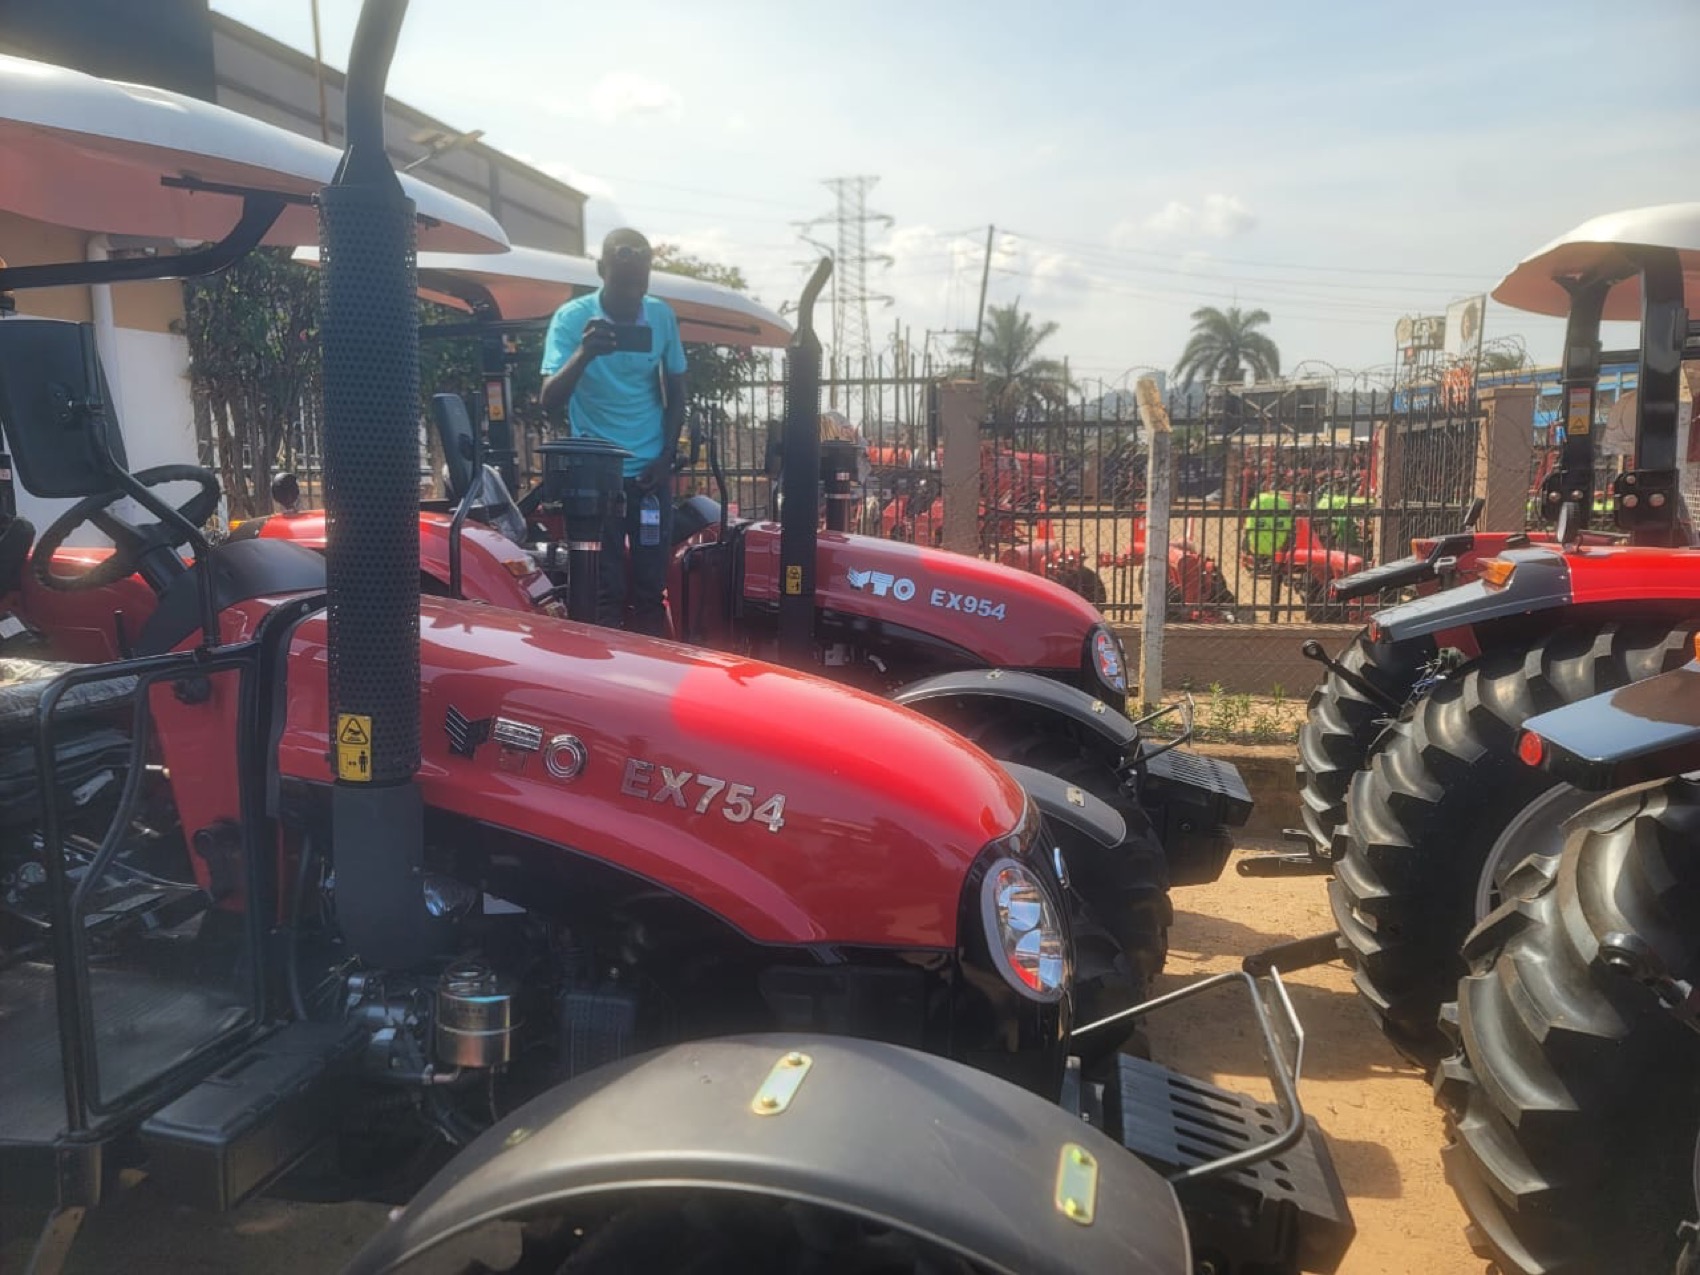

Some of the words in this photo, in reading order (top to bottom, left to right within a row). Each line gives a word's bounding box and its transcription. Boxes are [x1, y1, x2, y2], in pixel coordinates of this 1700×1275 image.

[846, 566, 916, 601] YTO
[929, 587, 1006, 620] EX954
[620, 757, 787, 834] EX754
